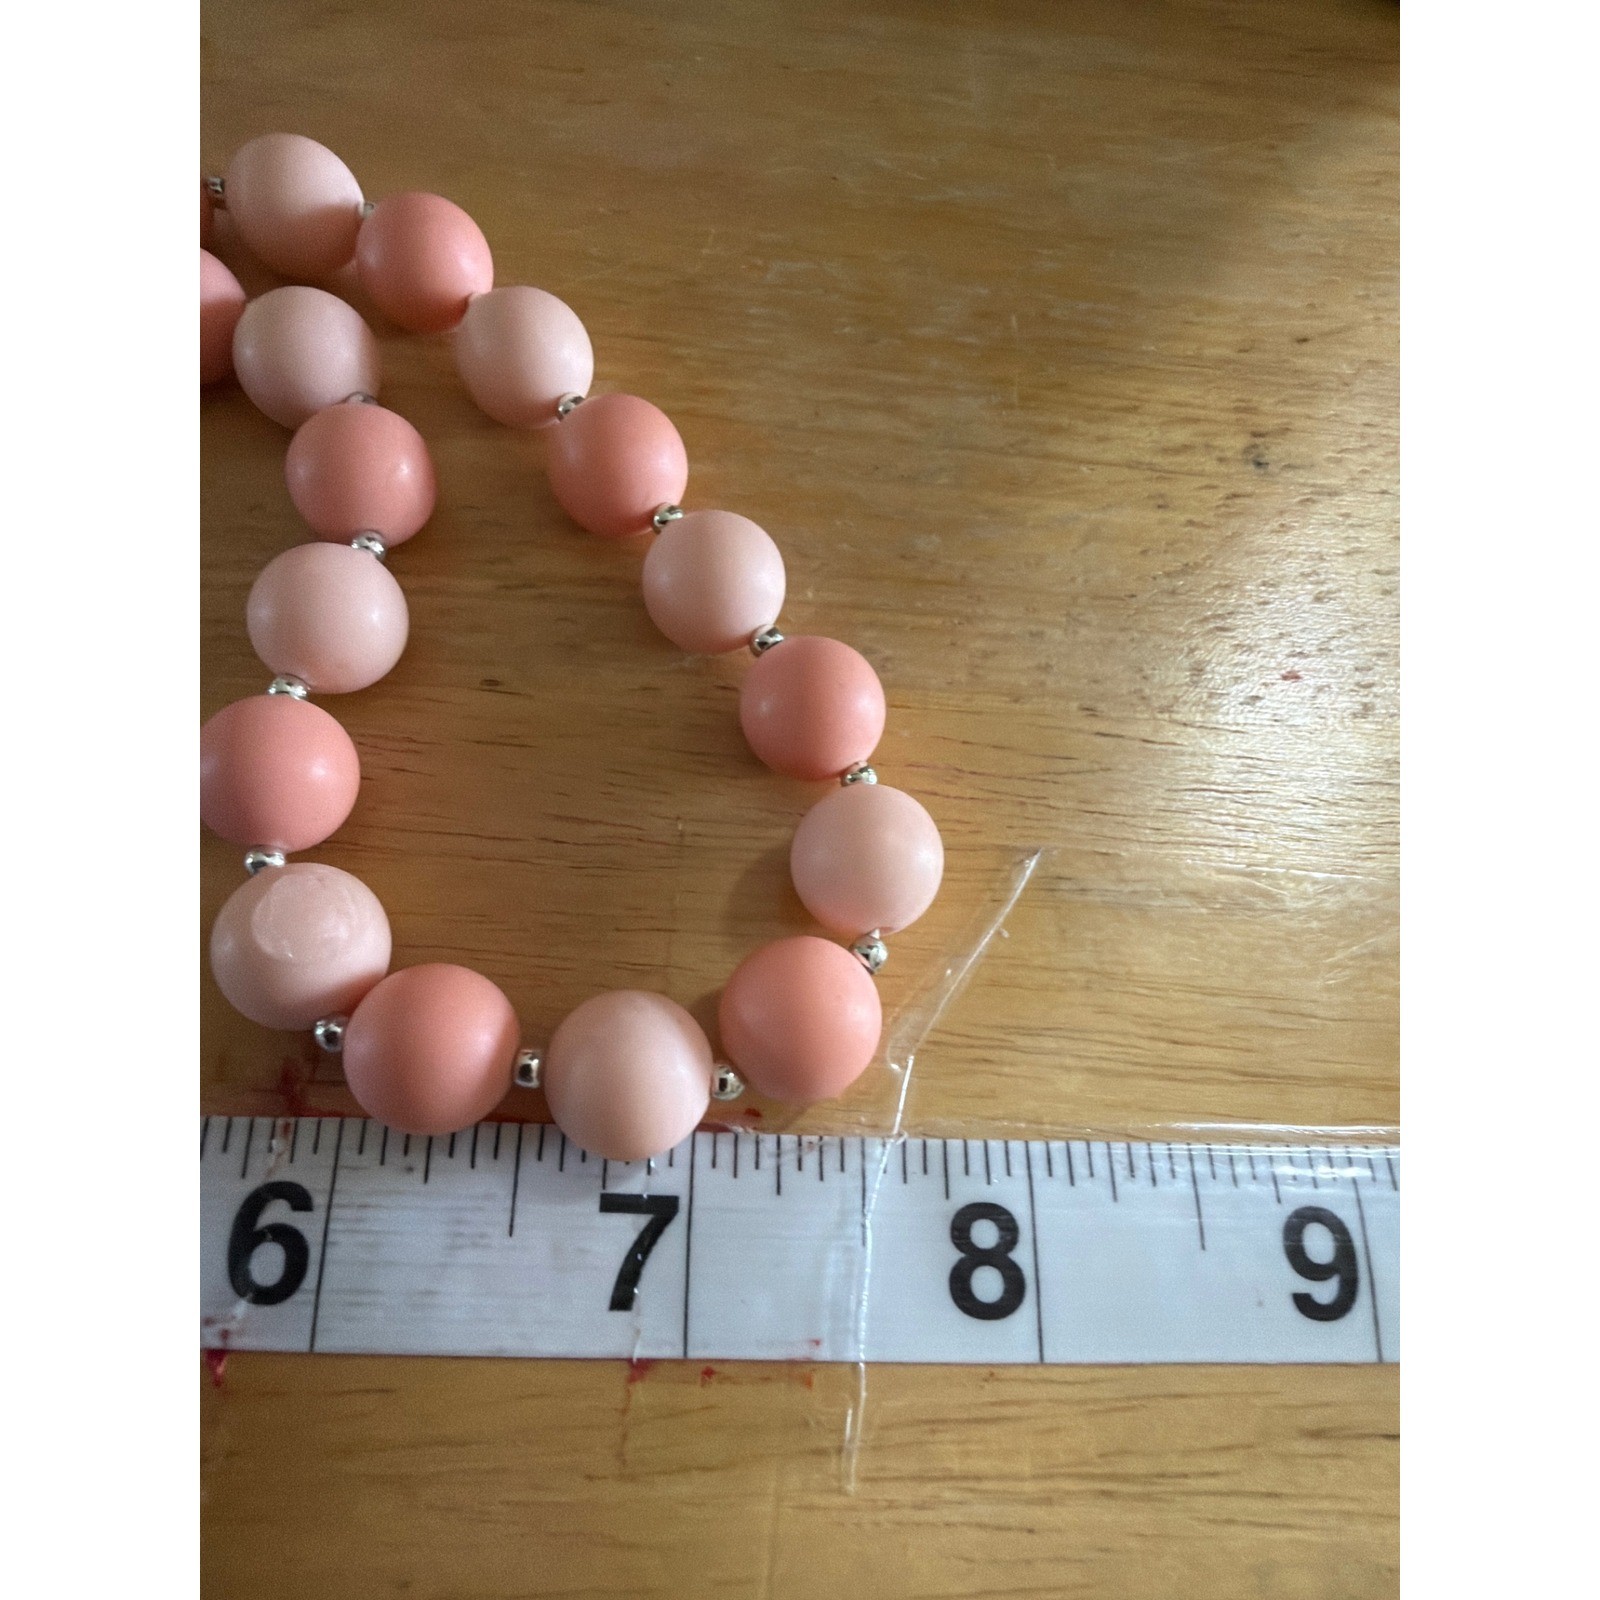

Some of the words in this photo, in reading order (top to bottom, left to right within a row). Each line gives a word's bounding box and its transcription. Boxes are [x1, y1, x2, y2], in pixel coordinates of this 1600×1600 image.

[227, 1180, 314, 1306] 6
[599, 1192, 680, 1312] 7
[948, 1202, 1026, 1321] 8
[1283, 1206, 1359, 1322] 9
